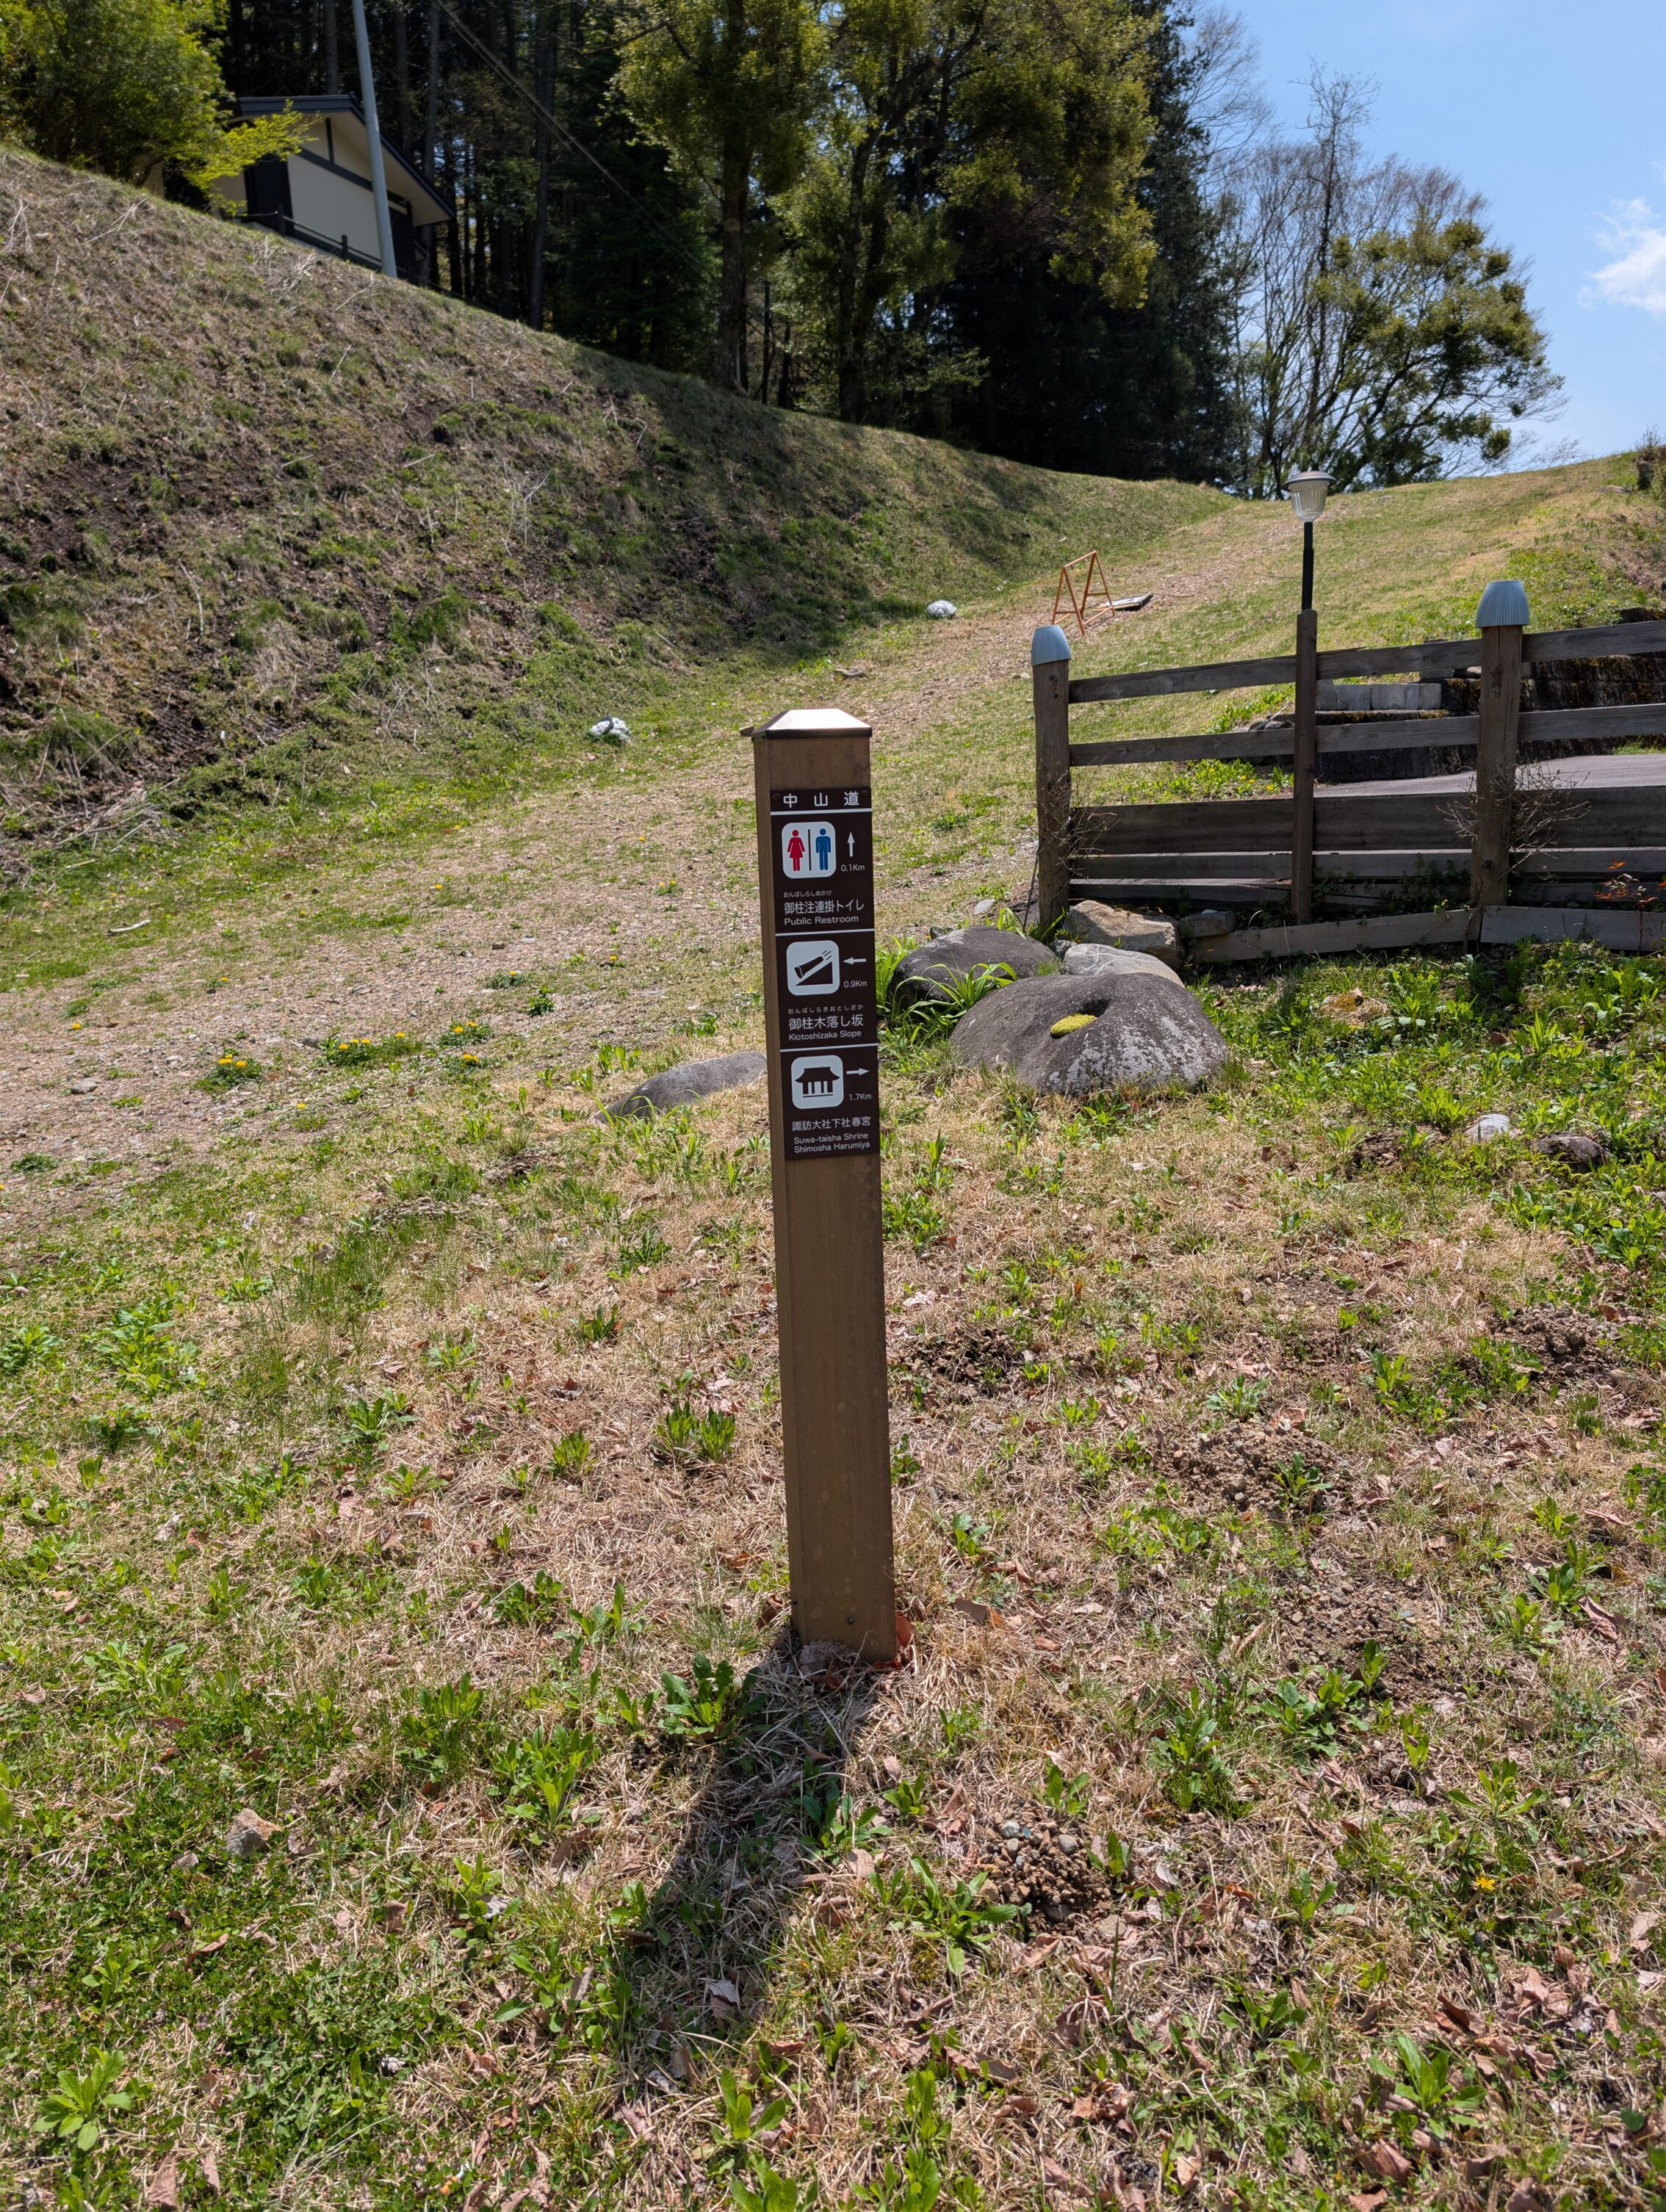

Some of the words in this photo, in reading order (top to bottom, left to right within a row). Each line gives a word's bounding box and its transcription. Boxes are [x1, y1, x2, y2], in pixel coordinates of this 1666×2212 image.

[783, 791, 859, 809] 中山道
[840, 864, 865, 872] 0.1Km
[783, 890, 832, 898] おんばしらしめかけ
[784, 899, 865, 915] 御柱注連掛トイレ
[784, 917, 812, 925] Public
[815, 916, 859, 925] Restroom
[787, 1004, 864, 1014] おんばしらきおとしざか
[788, 1013, 864, 1030] 御柱木落し坂
[788, 1031, 837, 1041] Kiotoshizaka
[840, 1030, 862, 1038] Slope
[848, 1093, 872, 1101] 1.7Km
[792, 1116, 871, 1132] 諏訪大社下社春宮
[793, 1134, 842, 1144] Suwa-taisha
[843, 1132, 869, 1141] Shrine
[794, 1143, 832, 1153] Shimosha
[834, 1141, 870, 1151] Harumiya
